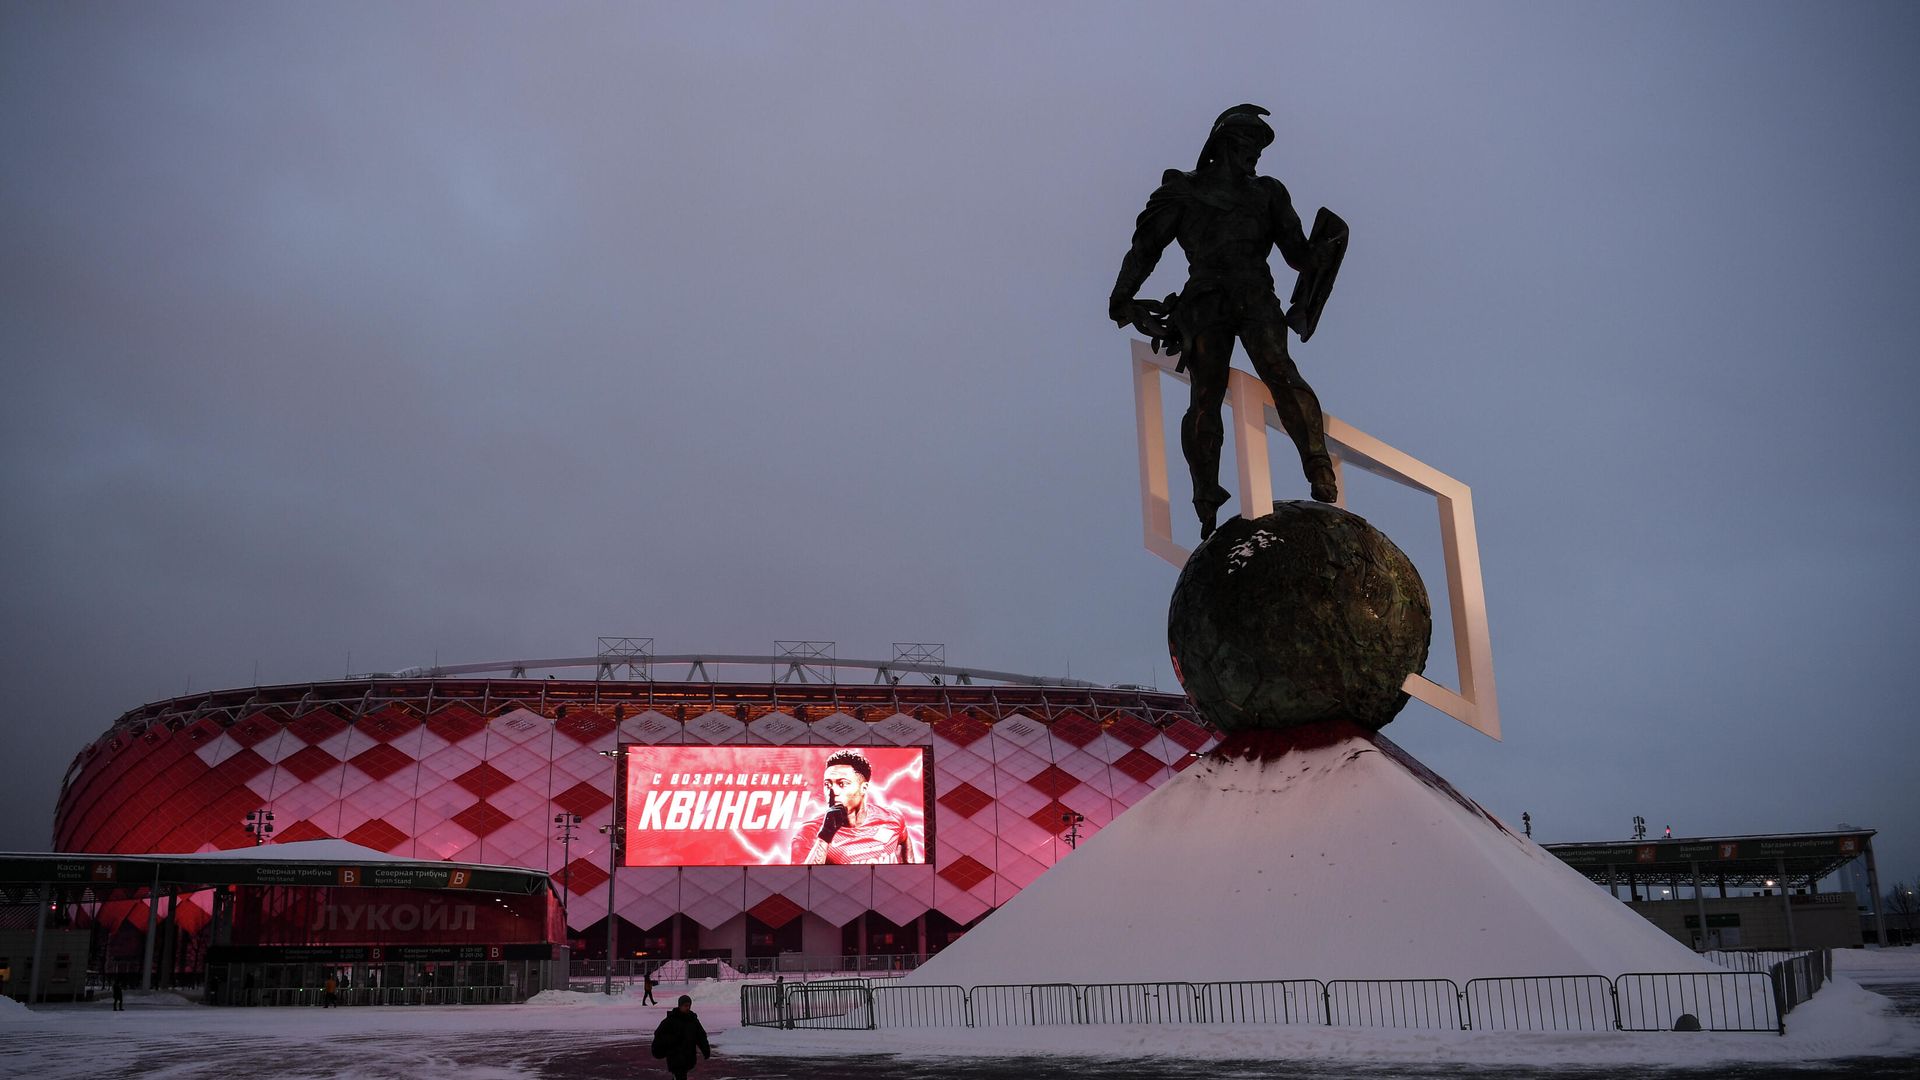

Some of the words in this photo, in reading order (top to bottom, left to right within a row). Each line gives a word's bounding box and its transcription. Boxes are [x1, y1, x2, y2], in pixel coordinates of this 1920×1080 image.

[652, 774, 663, 785] С
[670, 773, 809, 786] ВОЗВРАЩЕНИЕМ,
[57, 863, 86, 872] Кассы
[257, 867, 296, 877] Северная
[298, 869, 333, 878] трибуна
[376, 869, 414, 879] Северная
[416, 870, 448, 880] трибуна
[1815, 895, 1841, 905] SHOP
[312, 898, 477, 931] ЛУКОЙЛ
